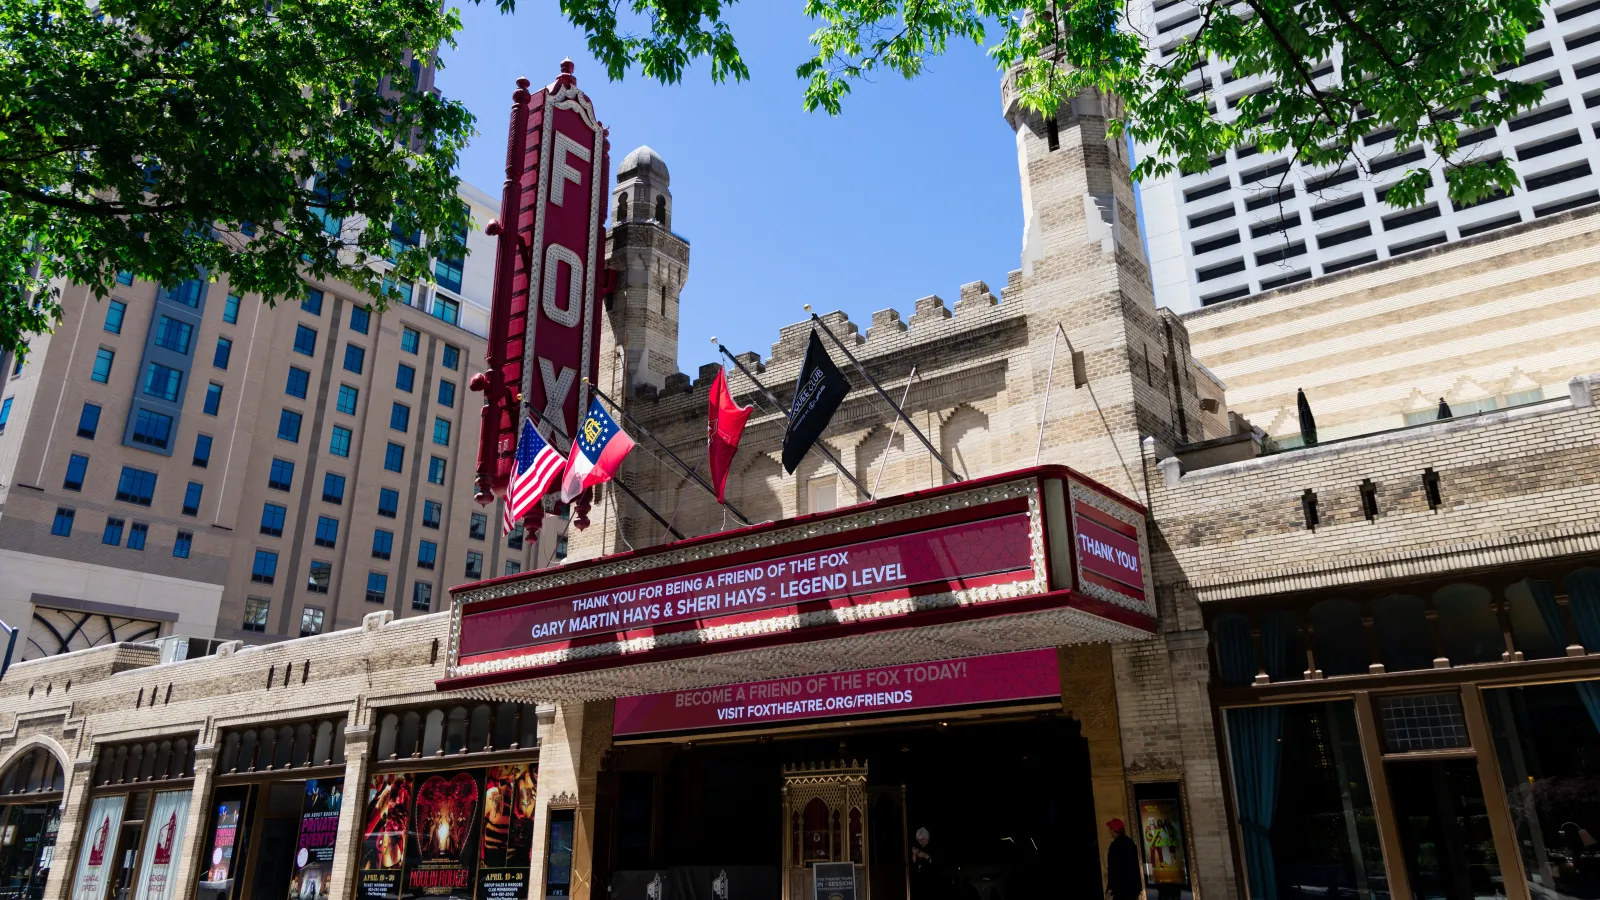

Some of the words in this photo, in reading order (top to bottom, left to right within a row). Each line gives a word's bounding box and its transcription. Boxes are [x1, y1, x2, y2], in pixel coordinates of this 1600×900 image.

[537, 130, 592, 453] FOX
[808, 369, 824, 391] CLUB
[1079, 533, 1115, 563] THANK
[1115, 548, 1138, 572] YOU!
[572, 594, 609, 612] THANK
[611, 590, 636, 605] YOU
[638, 587, 663, 600] FOR
[665, 578, 702, 596] BEING
[705, 579, 715, 589] A
[717, 567, 764, 586] FRIEND
[767, 562, 786, 577] OF
[789, 557, 816, 574] THE
[819, 551, 849, 568] FOX
[531, 619, 567, 638] GARY
[568, 611, 620, 633] MARTIN
[623, 603, 660, 624] HAYS
[663, 602, 673, 617] &
[676, 592, 721, 615] SHERI
[724, 586, 766, 607] HAYS
[780, 572, 847, 599] LEGEND
[852, 563, 906, 586] LEVEL
[675, 688, 732, 708] BECOME
[736, 687, 746, 701] A
[749, 681, 802, 700] FRIEND
[806, 677, 827, 694] OF
[831, 673, 862, 691] THE
[866, 669, 900, 688] FOX
[904, 662, 967, 683] TODAY!
[717, 706, 745, 720] VISIT
[747, 690, 913, 718] FOXTHEATRE.ORG/FRIENDS
[300, 832, 335, 846] EVENTS
[302, 817, 338, 833] PRIVATE
[409, 870, 438, 887] MOULIN
[439, 869, 468, 887] ROUGE!
[485, 873, 503, 881] APRIL
[505, 872, 511, 881] 19
[515, 872, 523, 881] 30
